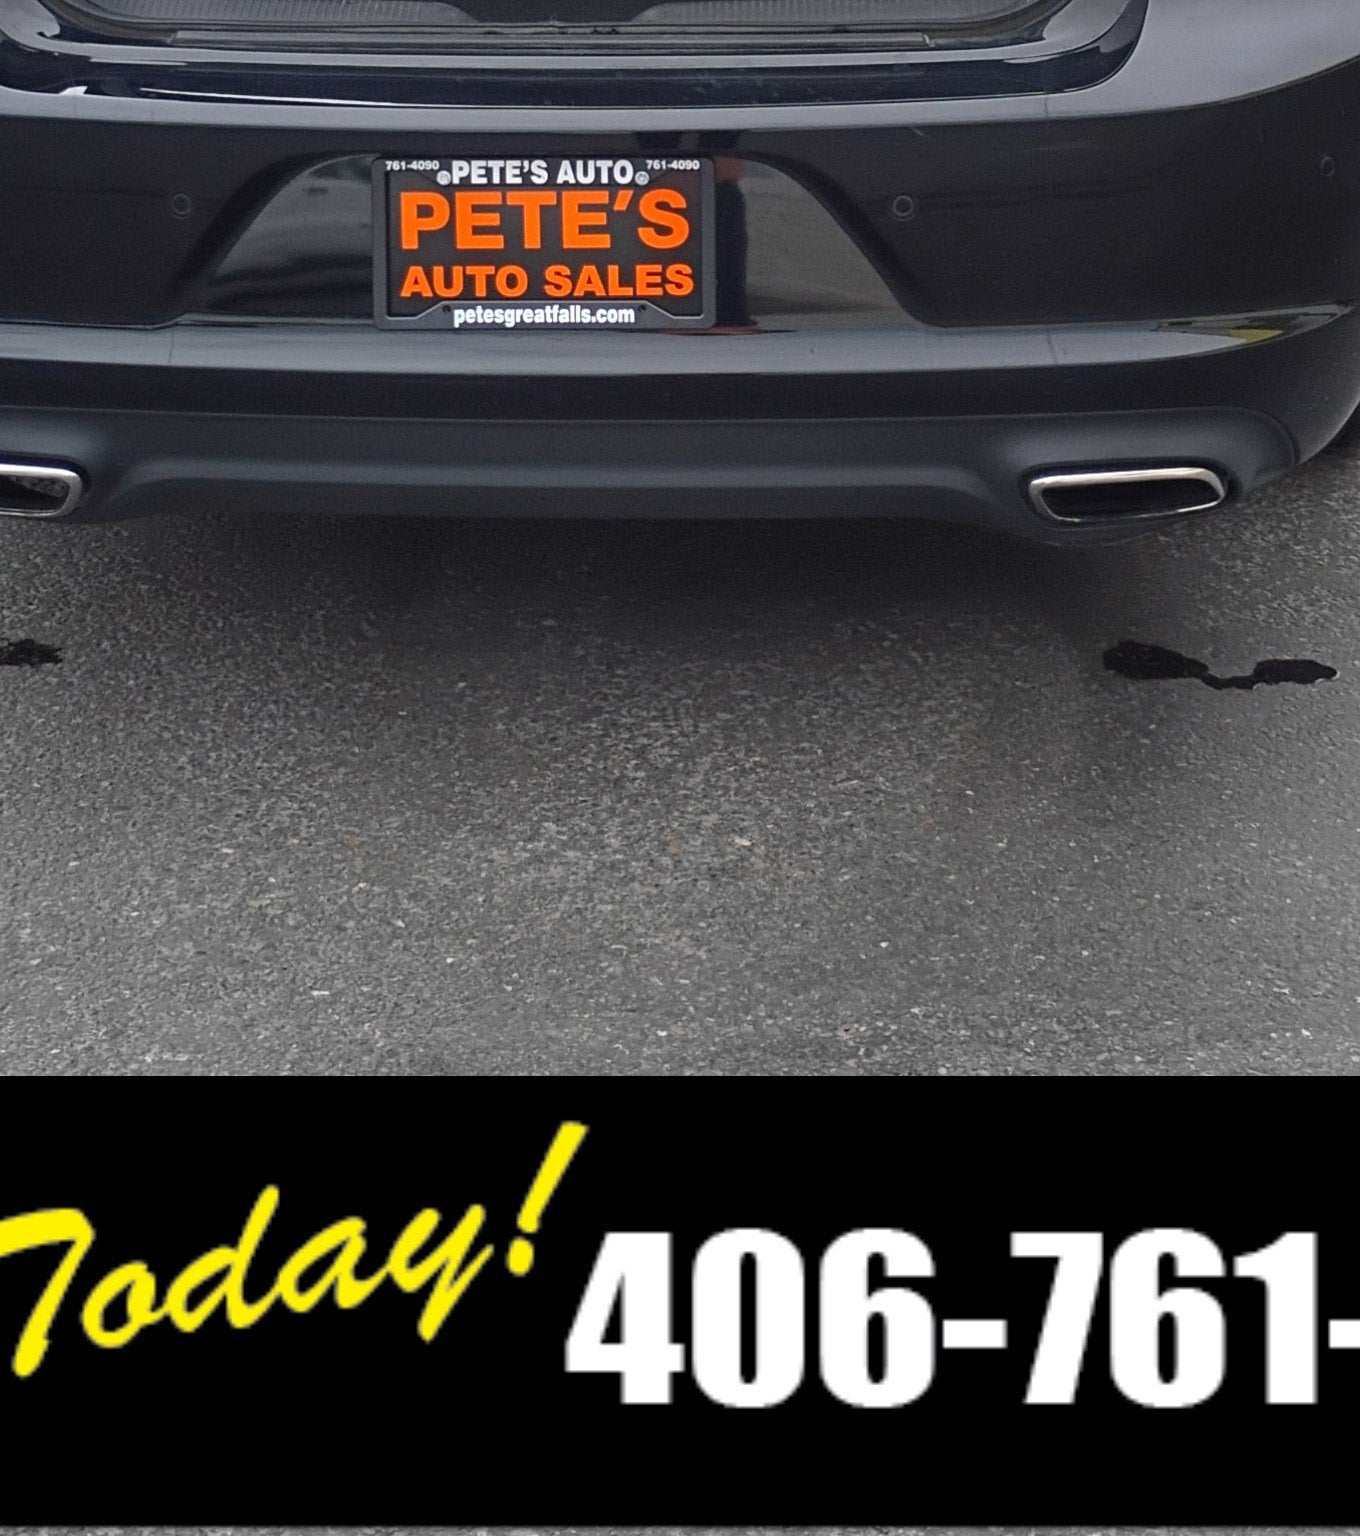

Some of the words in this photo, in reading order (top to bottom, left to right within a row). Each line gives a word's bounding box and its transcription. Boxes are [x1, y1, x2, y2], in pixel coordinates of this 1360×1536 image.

[385, 160, 439, 171] 761-4090
[452, 160, 548, 185] PETE'S
[556, 160, 634, 185] AUTO
[645, 159, 700, 170] 761-4090
[400, 189, 690, 250] PETE'S
[400, 265, 528, 297] AUTO
[544, 264, 694, 297] SALES
[453, 304, 636, 328] petesgreatfalls.com
